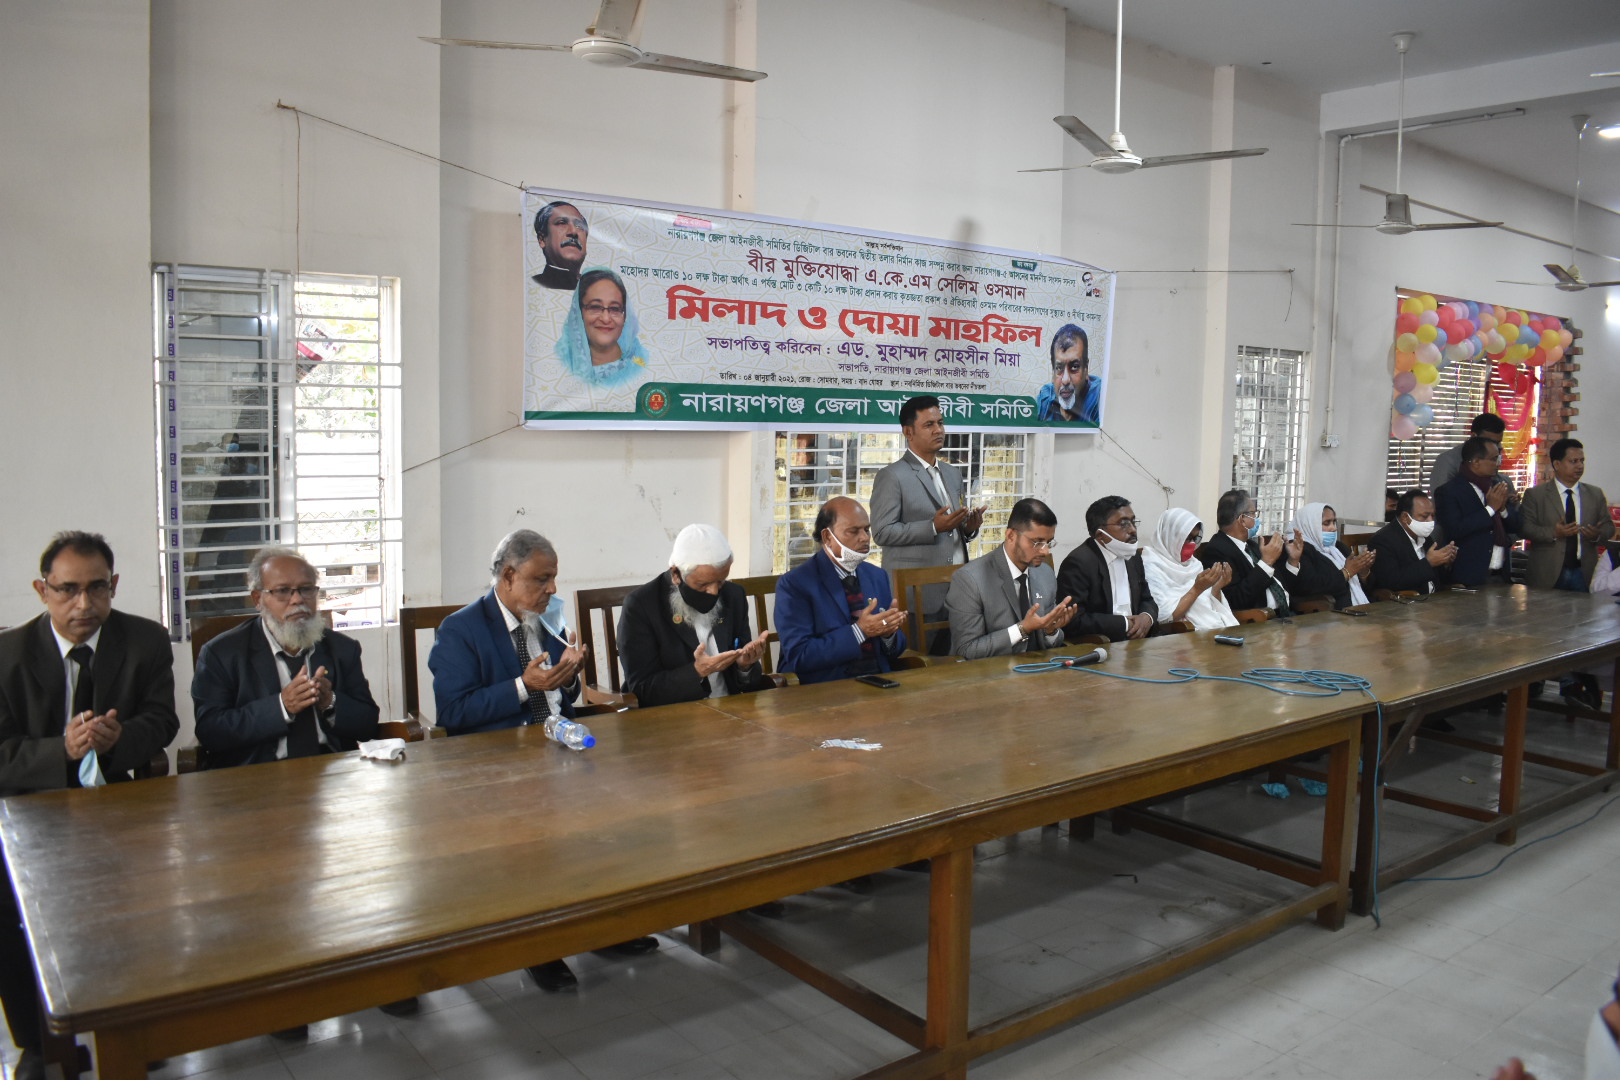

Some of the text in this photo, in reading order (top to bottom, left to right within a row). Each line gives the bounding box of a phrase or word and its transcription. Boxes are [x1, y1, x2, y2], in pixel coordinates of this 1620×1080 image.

[708, 233, 727, 244] জেলা
[728, 235, 764, 248] আইনজীবী
[766, 237, 791, 250] সমিতির
[793, 241, 821, 255] ডিজিটাল
[822, 247, 834, 257] বার
[836, 247, 857, 259] ভবনের
[859, 248, 877, 261] দ্বিতীয়
[878, 253, 895, 264] তলার
[914, 257, 927, 268] কাজ
[946, 262, 960, 272] করার
[962, 264, 973, 274] জন্য
[620, 265, 649, 277] মহোদয়
[652, 268, 679, 280] আরোও
[682, 271, 693, 281] ১০
[695, 272, 711, 283] লক্ষ
[712, 271, 728, 285] টাকা
[730, 274, 749, 287] অর্থাৎ
[751, 278, 758, 287] এ
[760, 276, 778, 289] পর্যন্ত
[779, 278, 794, 290] মোট
[796, 283, 802, 291] ৩
[804, 281, 822, 293] কোটি
[824, 285, 833, 295] ১০
[835, 285, 848, 295] লক্ষ
[849, 285, 863, 298] টাকা
[865, 288, 881, 299] প্রদান
[882, 291, 898, 301] করায়
[924, 295, 941, 304] প্রকাশ
[943, 298, 948, 306] ও
[980, 300, 997, 310] ওসমান
[746, 249, 1027, 301] বীর মুক্তিযোদ্ধা এ.কে.এম সেলিম ওসমান
[666, 284, 1042, 348] মিলাদ ও দোয়া মাহফিল
[707, 336, 771, 355] সভাপতিত্ব
[775, 338, 821, 356] করিবেন
[837, 341, 869, 359] এড.
[876, 343, 929, 363] মুহাম্মদ
[934, 345, 990, 366] মোহসীন
[994, 348, 1021, 367] মিয়া
[719, 370, 737, 381] তারিখ
[754, 372, 776, 383] জানুয়ারী
[778, 375, 796, 384] ২০২১,
[838, 362, 990, 379] সভাপতি, নারায়ণগঞ্জ জেলা আইনজীবী সমিতি
[679, 392, 805, 415] নারায়ণগঞ্জ
[815, 396, 871, 416] জেলা
[981, 396, 1035, 420] সমিতি
